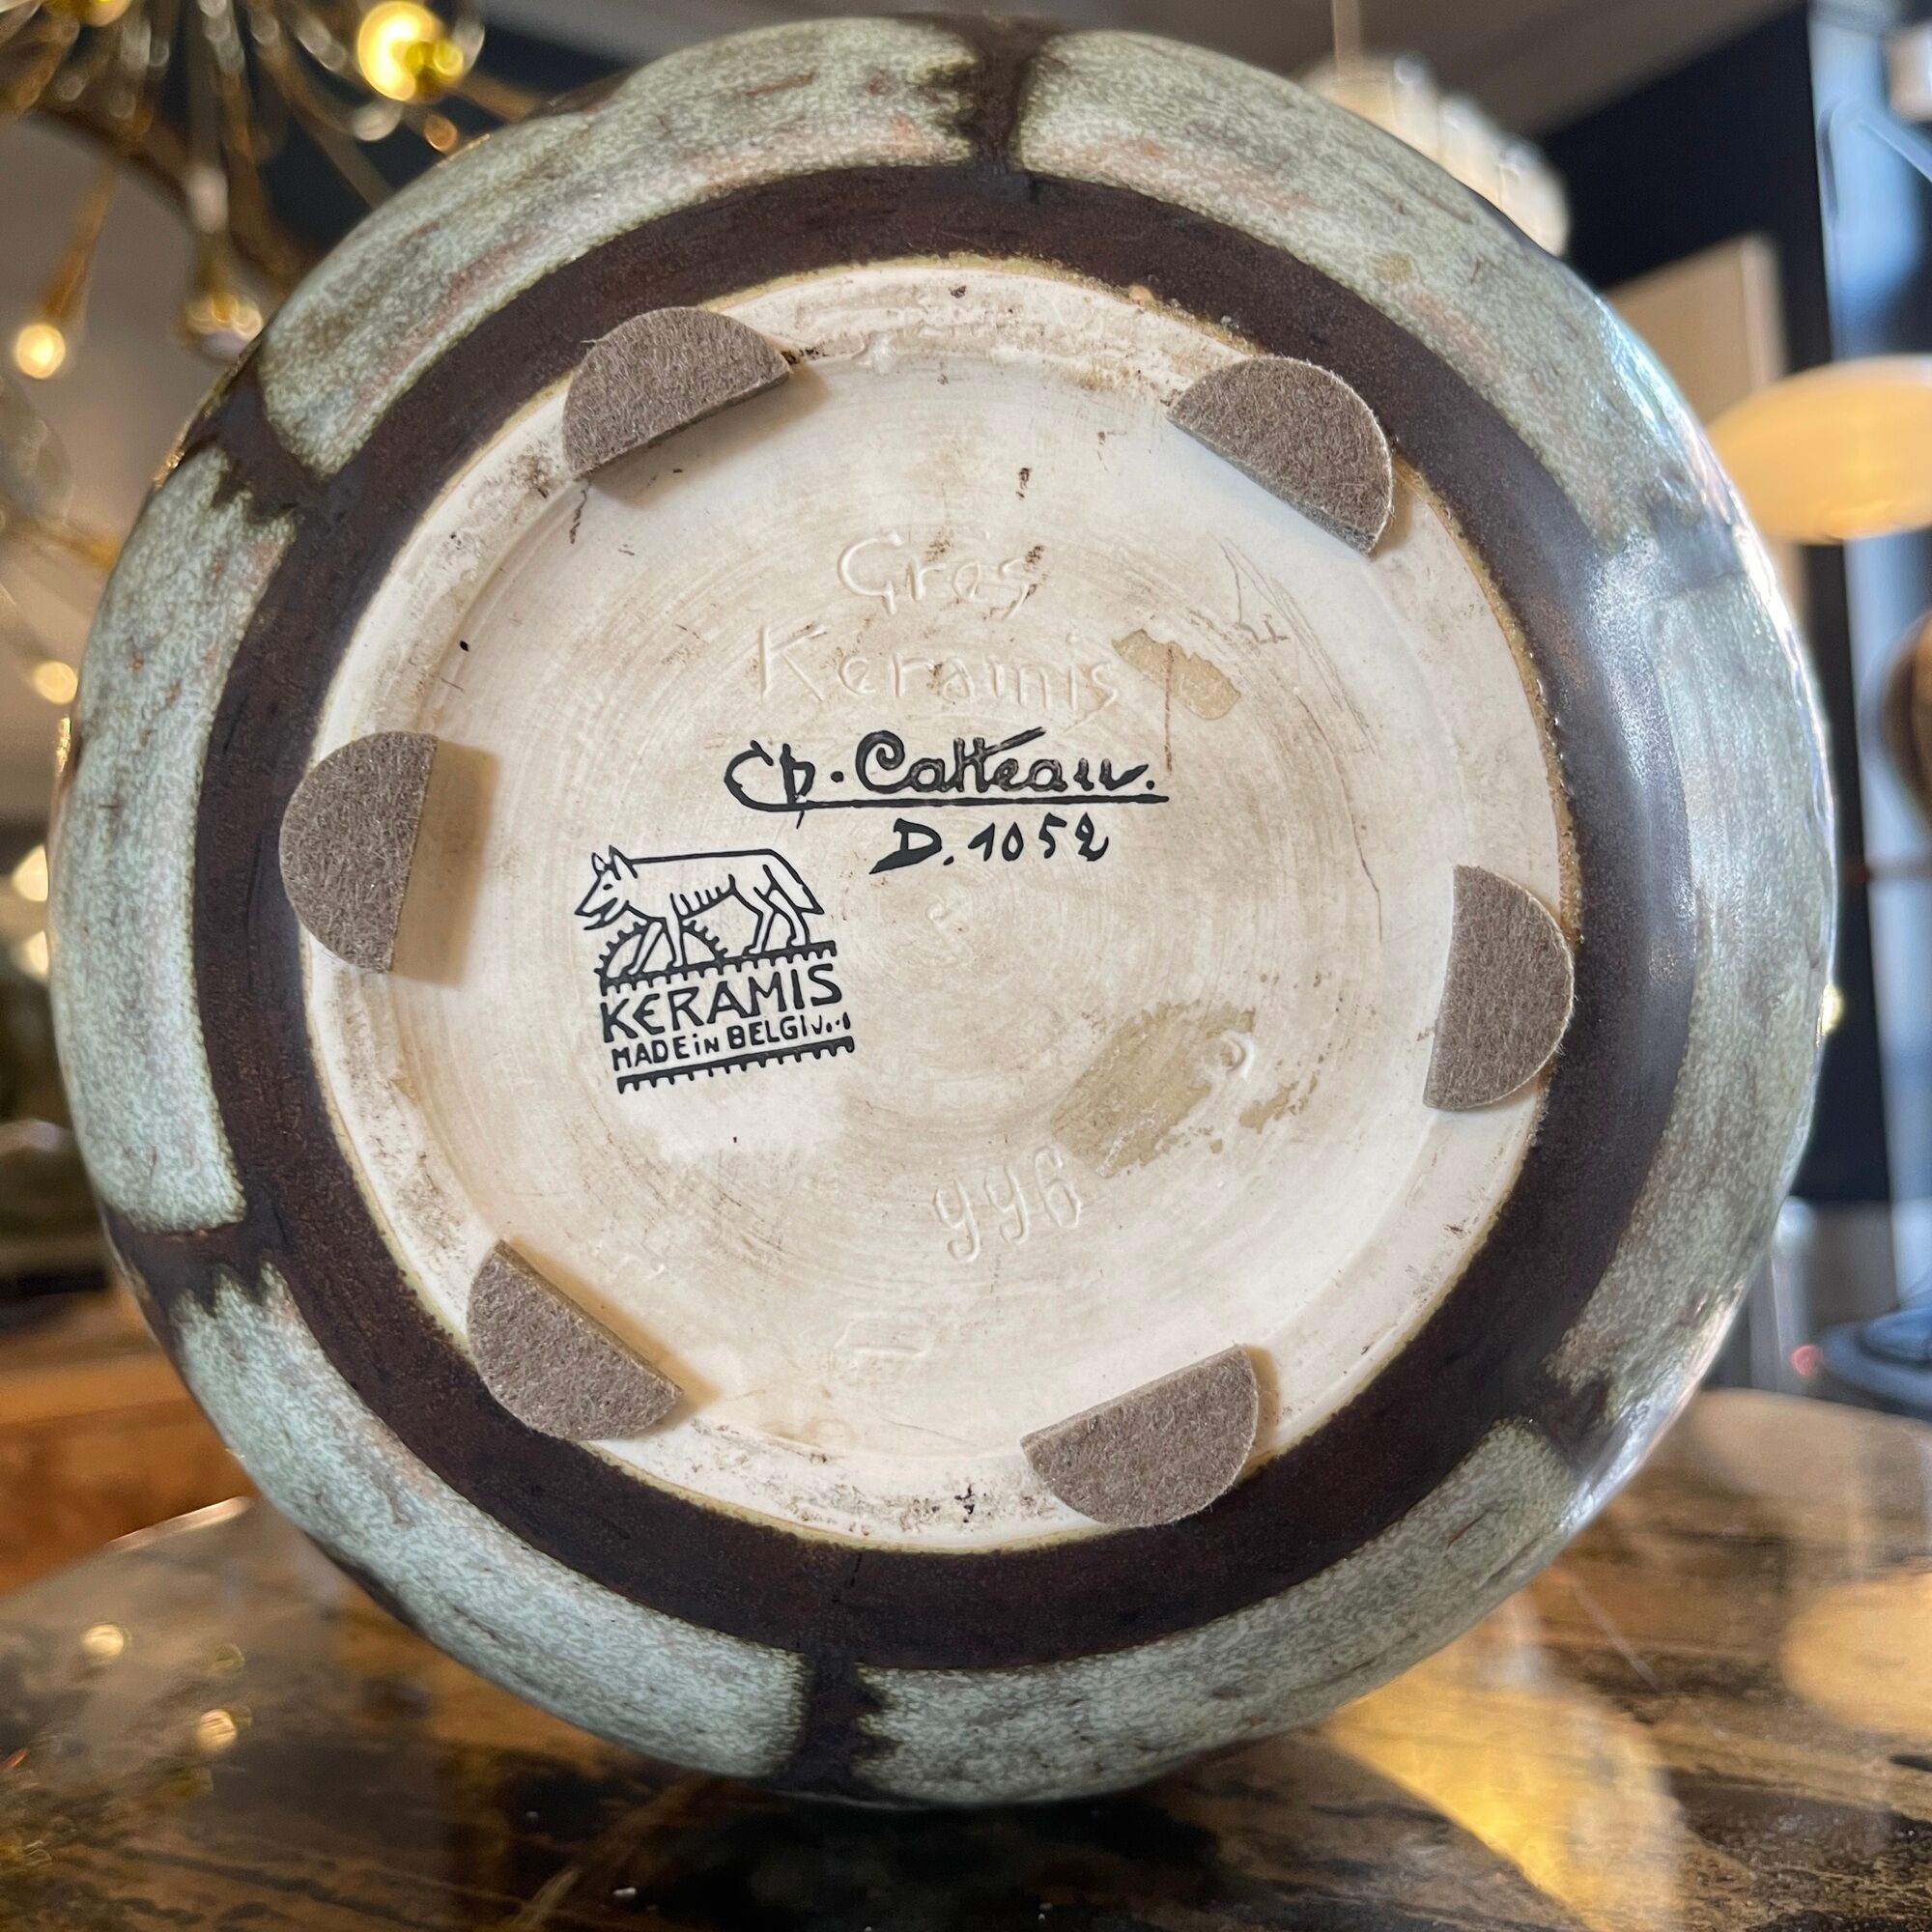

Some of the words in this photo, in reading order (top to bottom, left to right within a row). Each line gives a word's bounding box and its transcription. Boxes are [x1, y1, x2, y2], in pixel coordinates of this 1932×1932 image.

[758, 623, 1119, 712] Keramis
[599, 962, 843, 1044] KERAMIS
[611, 1035, 691, 1072] MADE
